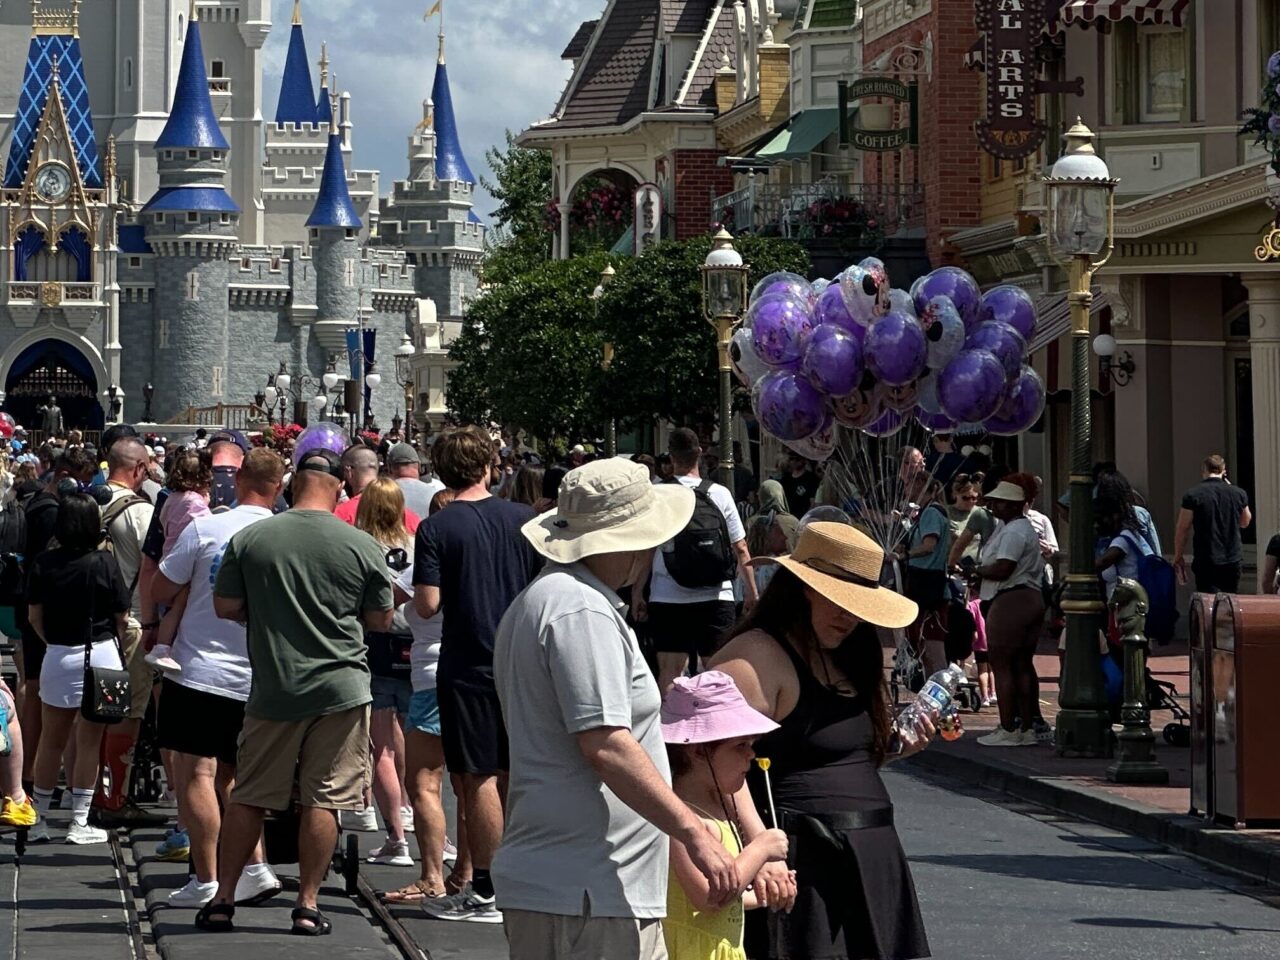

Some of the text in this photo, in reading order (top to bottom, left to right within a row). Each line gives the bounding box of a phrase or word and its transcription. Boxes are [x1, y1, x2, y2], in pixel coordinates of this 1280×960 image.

[853, 81, 905, 97] FRESH ROASTED
[997, 49, 1024, 118] ARTS
[855, 133, 903, 147] COFFEE
